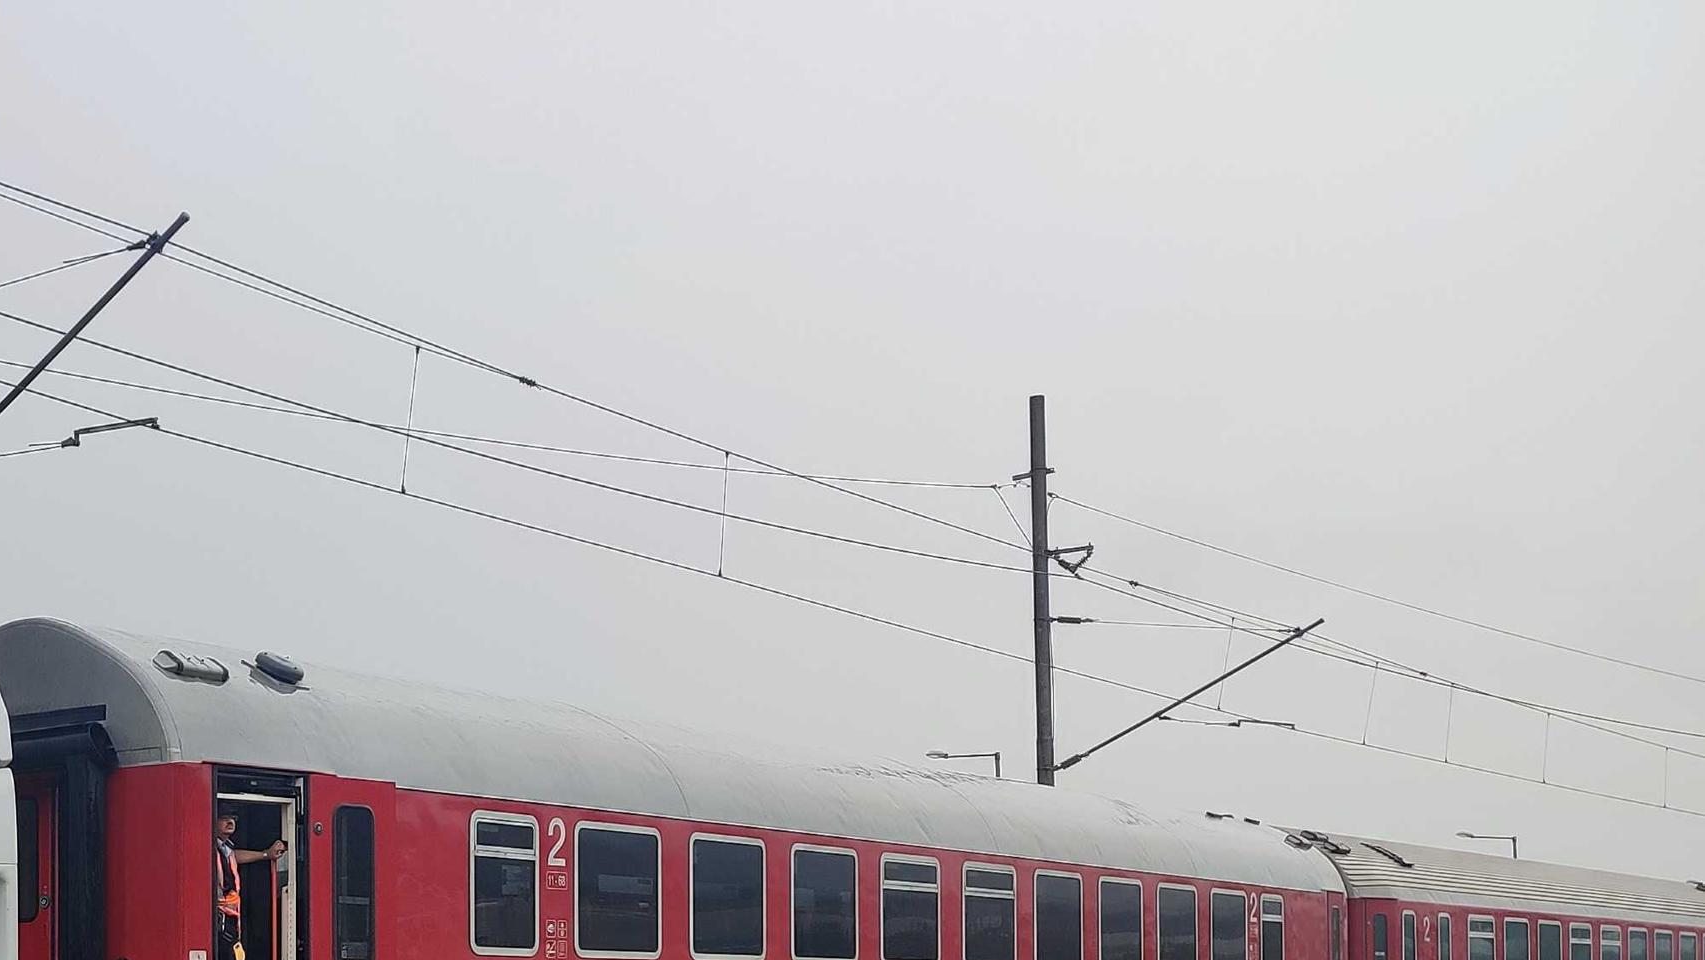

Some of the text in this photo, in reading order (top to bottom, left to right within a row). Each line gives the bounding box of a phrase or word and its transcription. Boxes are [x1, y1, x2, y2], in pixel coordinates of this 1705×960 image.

[548, 817, 566, 867] 2
[1249, 892, 1258, 923] 2
[1423, 916, 1431, 942] 2
